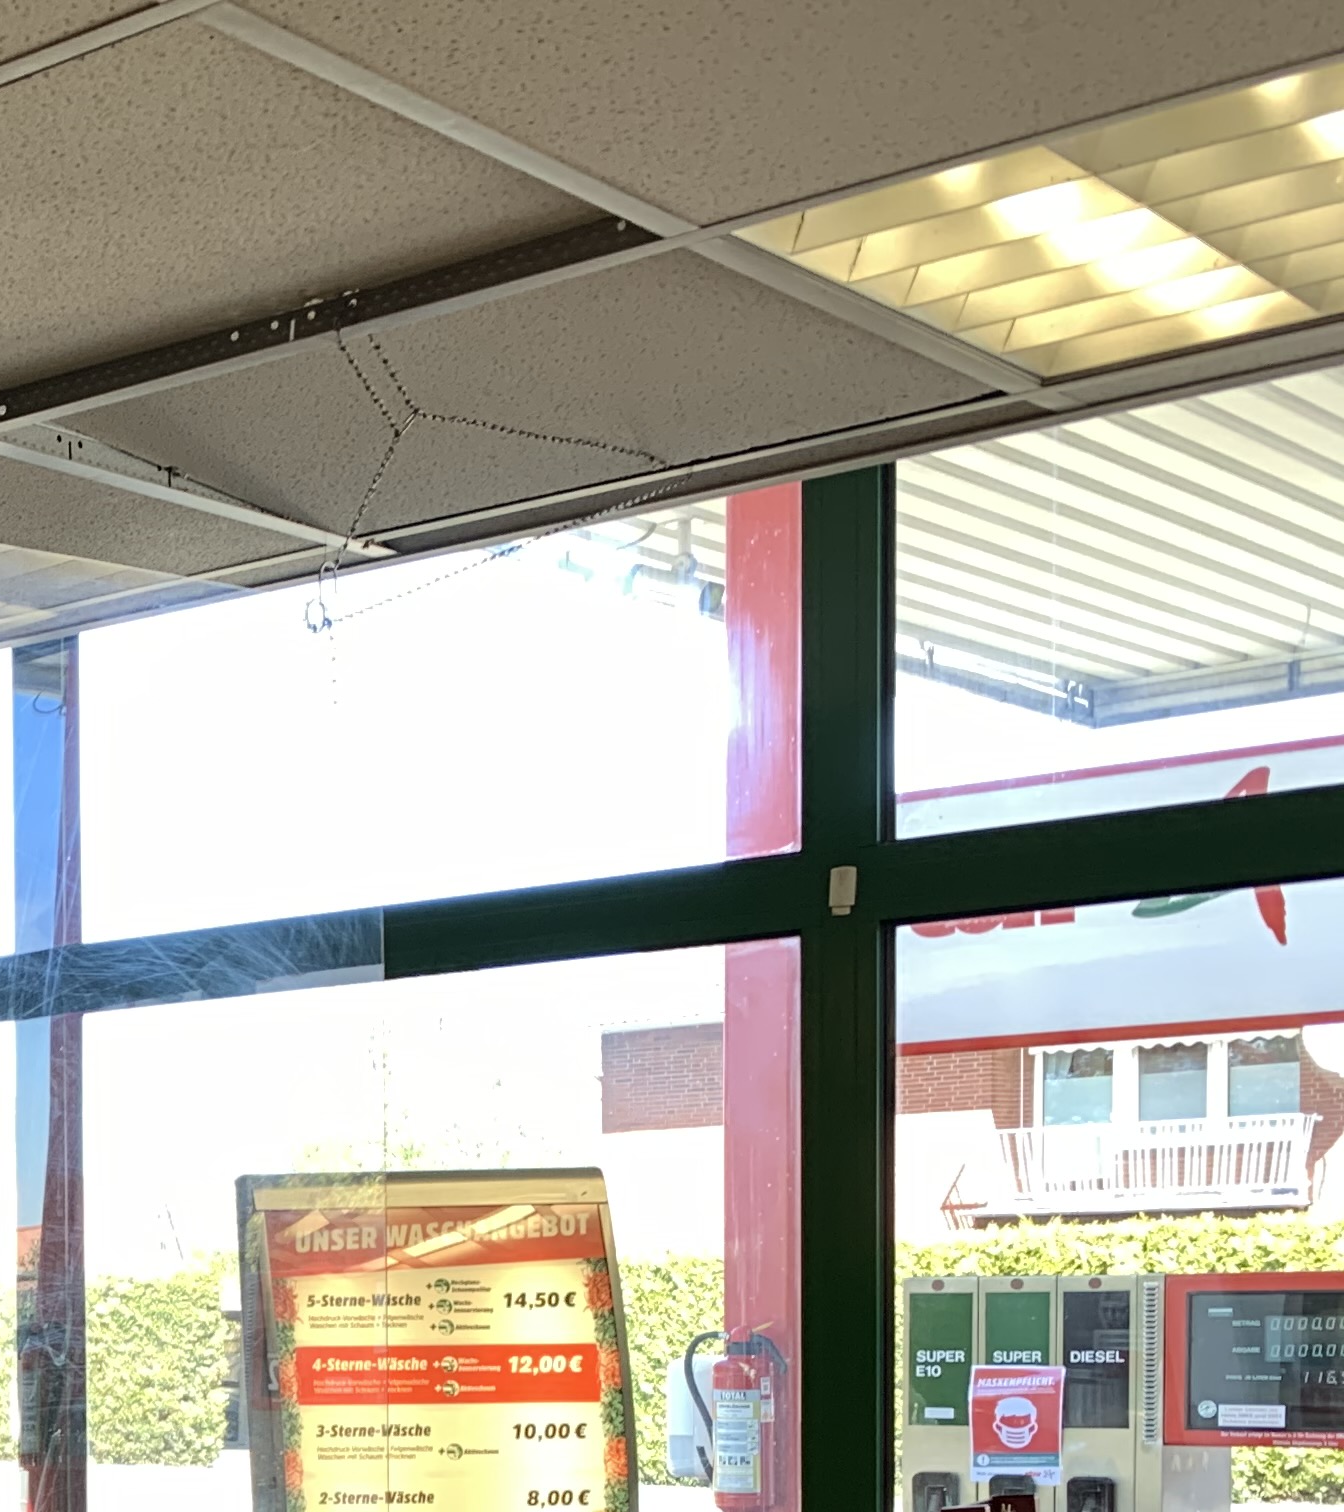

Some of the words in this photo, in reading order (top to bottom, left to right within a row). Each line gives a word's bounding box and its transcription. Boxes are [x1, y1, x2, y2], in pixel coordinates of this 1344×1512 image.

[295, 1227, 377, 1253] UNSER
[307, 1294, 422, 1307] 5-Sterne-Wäsche
[503, 1292, 560, 1309] 14,50
[564, 1292, 576, 1307] €
[312, 1357, 428, 1372] 4-Sterne-Wäsche
[508, 1356, 565, 1374] 12,00
[569, 1356, 583, 1373] €
[916, 1350, 965, 1363] SUPER
[993, 1350, 1042, 1363] SUPER
[1070, 1351, 1125, 1363] DIESEL
[916, 1364, 941, 1378] E10
[316, 1424, 432, 1439] 3-Sterne-Wäsche
[513, 1423, 571, 1442] 10,00
[575, 1423, 587, 1439] €
[319, 1491, 434, 1505] 2-Sterne-Wäsche
[527, 1490, 574, 1508] 8,00
[578, 1490, 590, 1506] €
